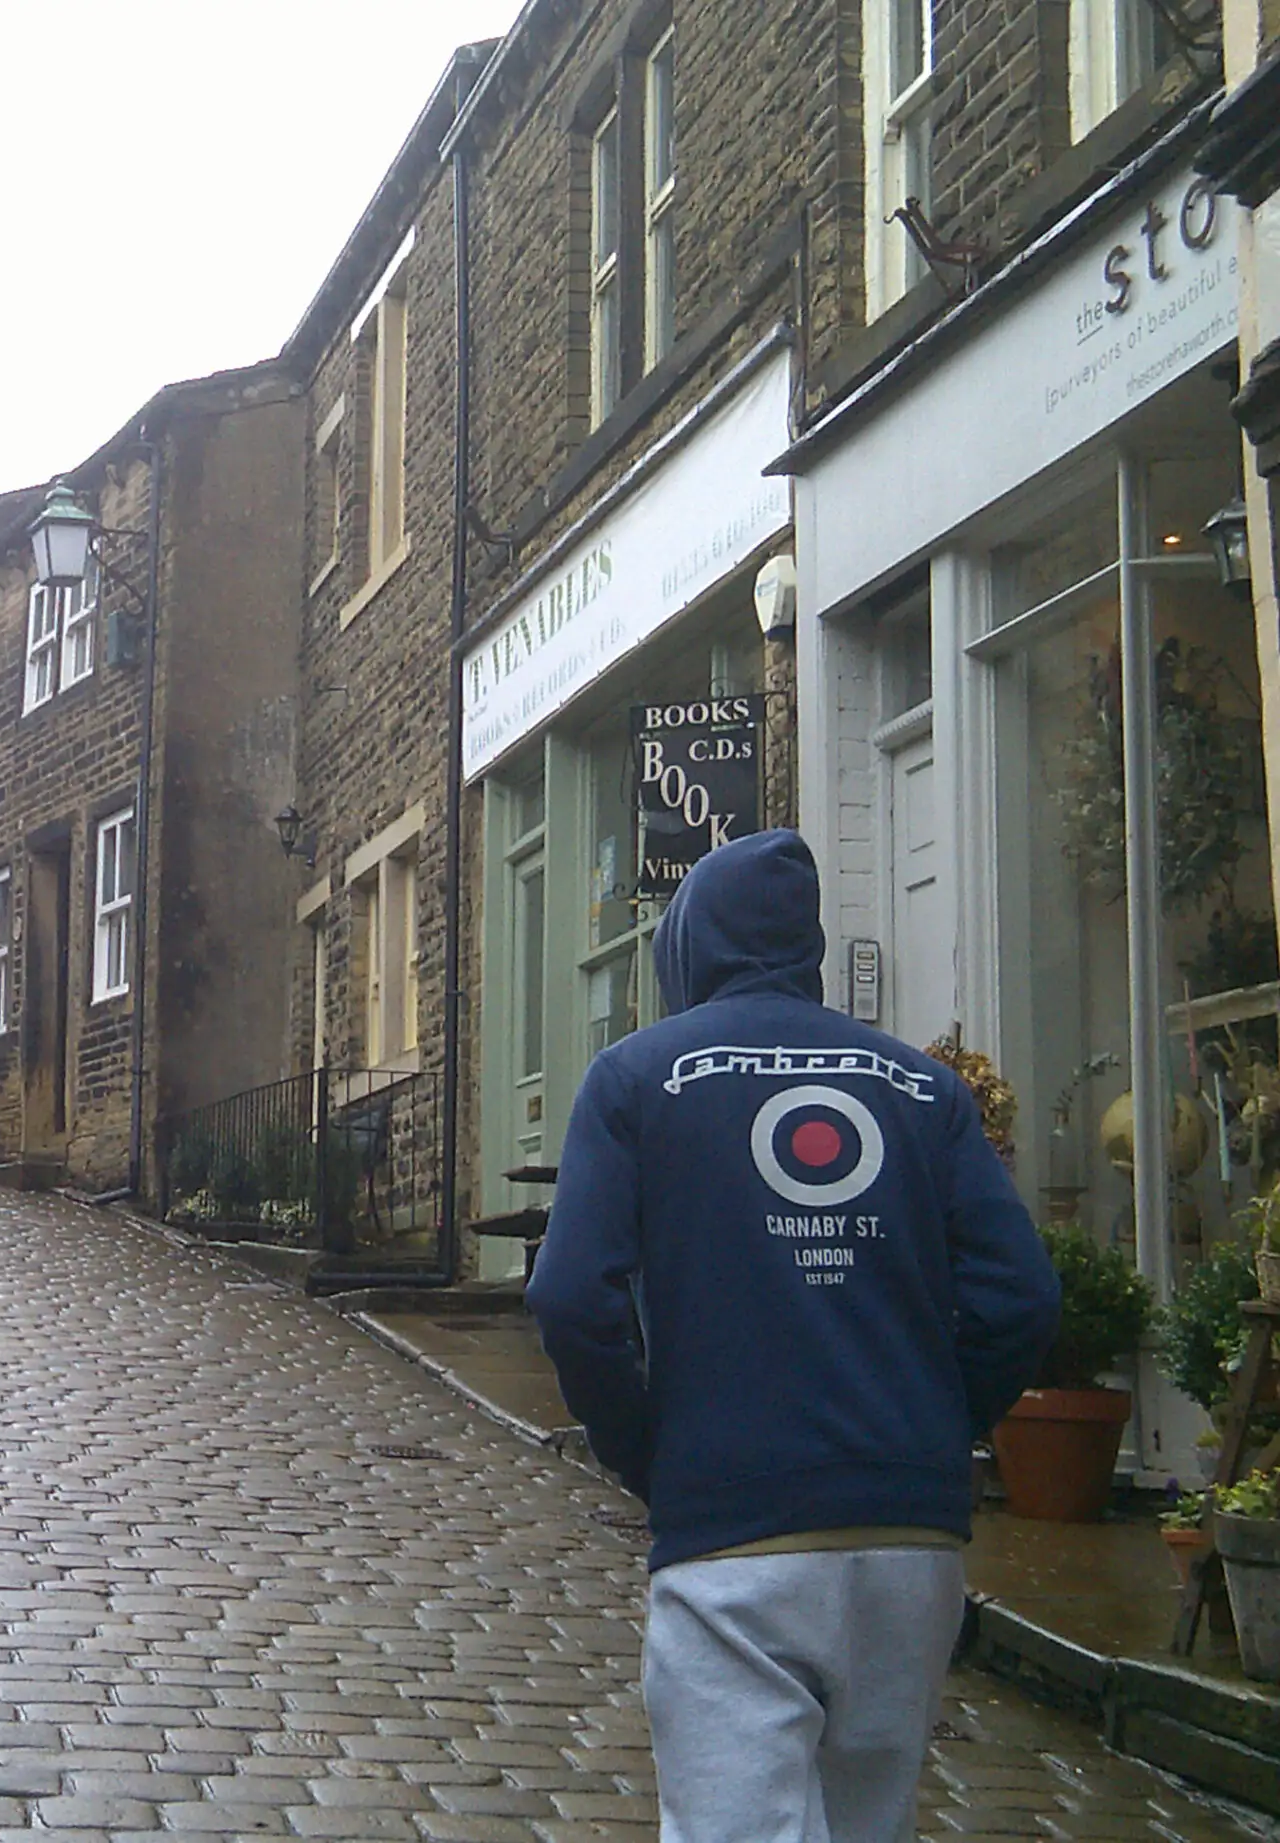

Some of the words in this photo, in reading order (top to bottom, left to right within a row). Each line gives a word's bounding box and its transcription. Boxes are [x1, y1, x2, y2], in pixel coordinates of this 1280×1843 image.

[1075, 302, 1104, 335] the
[1128, 317, 1143, 349] of
[1147, 258, 1221, 334] beautiful
[491, 539, 613, 685] VENABLES
[645, 698, 750, 729] BOOKS
[688, 738, 753, 762] C.D.s
[641, 741, 736, 851] BOOK
[766, 1214, 848, 1239] CARNABY
[856, 1215, 886, 1239] ST.
[794, 1247, 855, 1267] LONDON
[805, 1273, 822, 1285] EST
[823, 1273, 846, 1285] 1947
